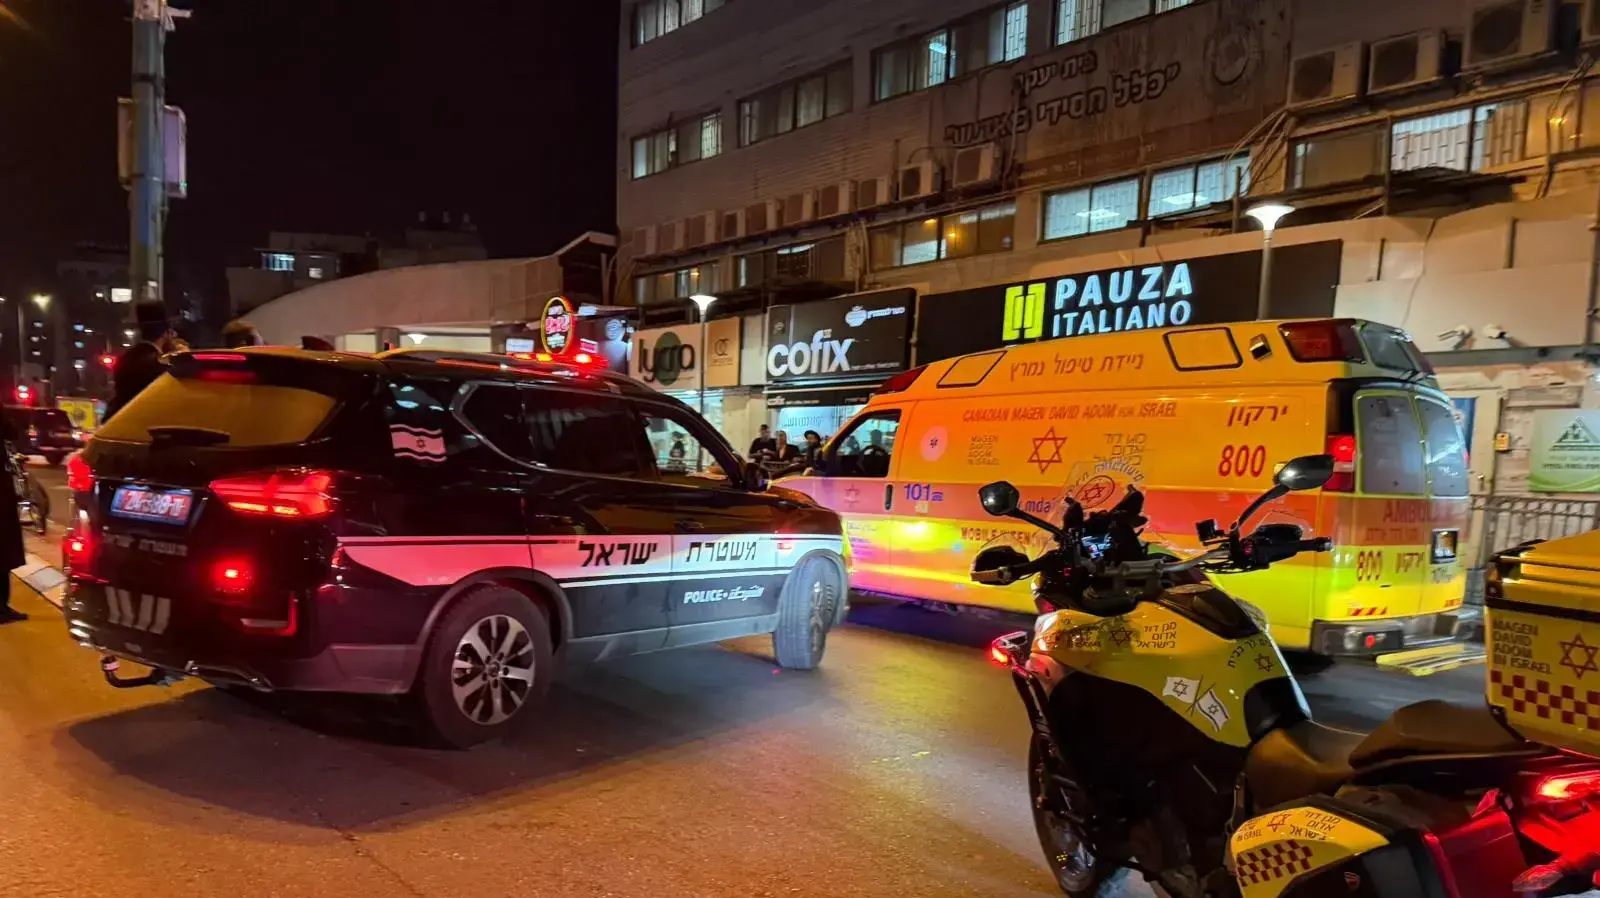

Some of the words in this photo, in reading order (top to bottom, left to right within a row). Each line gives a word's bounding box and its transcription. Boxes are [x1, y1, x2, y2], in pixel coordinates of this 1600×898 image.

[1061, 50, 1098, 78] בית
[1054, 262, 1193, 310] PAUZA
[1052, 300, 1192, 337] ITALIANO
[767, 329, 855, 377] cofix
[1100, 353, 1145, 372] ניידת
[1010, 361, 1046, 382] נמרץ
[1055, 354, 1093, 375] טיפול
[963, 408, 1008, 422] CANADIAN
[1011, 406, 1045, 421] MAGEN
[1049, 405, 1080, 420] DAVID
[1082, 404, 1117, 419] ADOM
[1138, 402, 1178, 417] ISRAEL
[1228, 404, 1289, 427] ירקון
[1219, 445, 1267, 478] 800
[904, 483, 931, 501] 101
[578, 541, 657, 567] ישראל
[685, 541, 757, 563] משטרת
[683, 590, 723, 604] POLICE
[1152, 631, 1177, 641] אדום
[1493, 619, 1539, 636] MAGEN
[1136, 640, 1177, 649] בישראל
[1493, 631, 1532, 646] DAVID
[1493, 642, 1532, 659] ADOM
[1493, 654, 1506, 665] IN
[1510, 657, 1553, 675] ISRAEL
[1306, 820, 1336, 831] אדום
